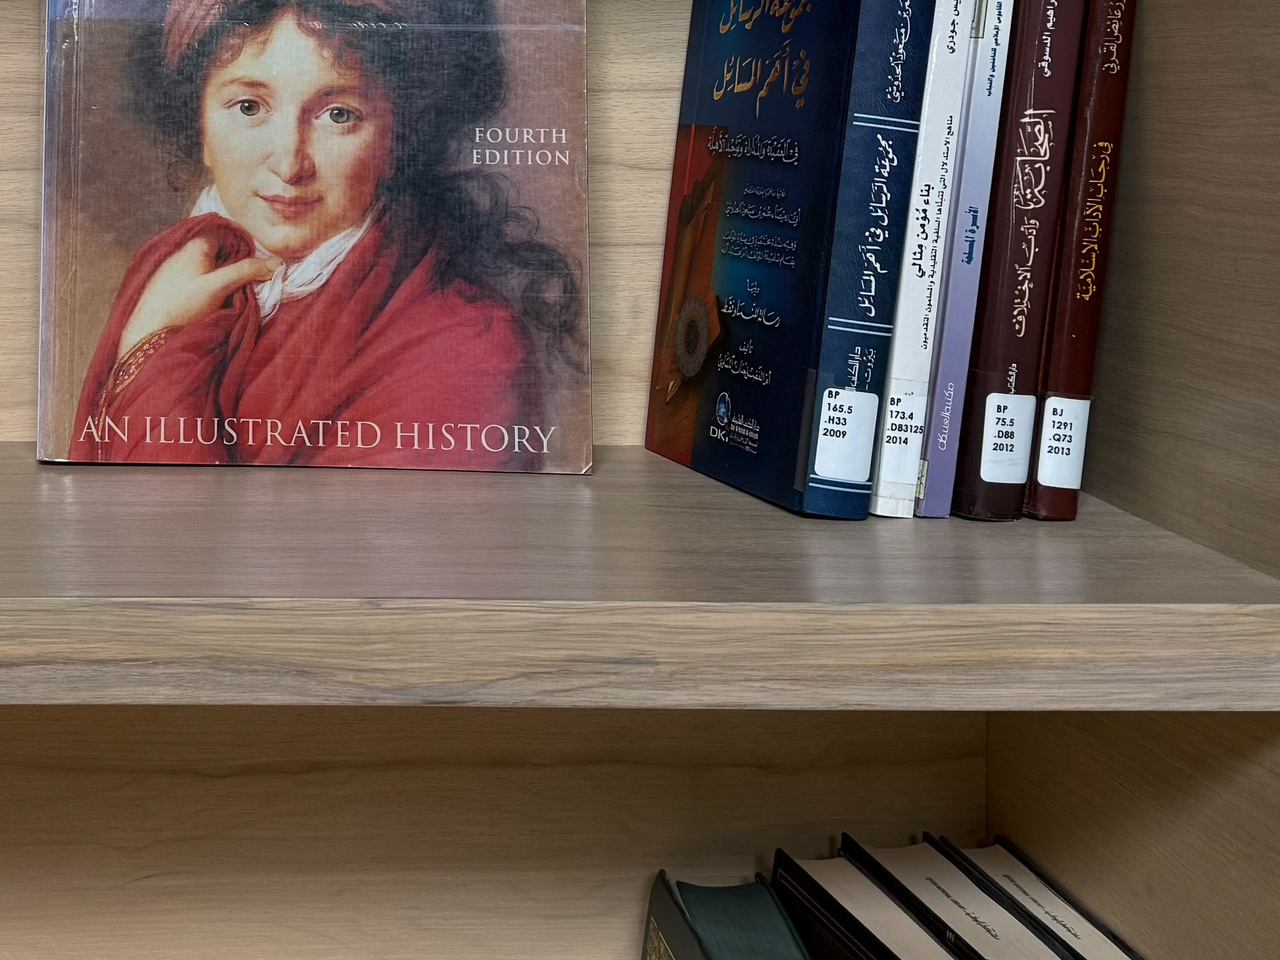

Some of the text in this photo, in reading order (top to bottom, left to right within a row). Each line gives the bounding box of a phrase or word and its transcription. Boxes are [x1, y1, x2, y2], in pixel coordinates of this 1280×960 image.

[945, 18, 959, 54] جودري
[1037, 31, 1056, 77] الدسوقي
[474, 126, 567, 144] FOURTH
[471, 148, 570, 166] EDITION
[917, 183, 934, 205] بناء
[827, 390, 840, 399] BP
[890, 397, 901, 406] BP
[826, 402, 853, 414] 165.5
[996, 404, 1008, 413] BP
[1052, 407, 1064, 417] BJ
[889, 410, 914, 420] 173.4
[824, 416, 847, 426] .H33
[995, 417, 1015, 427] 75.5
[1051, 420, 1073, 431] 1291
[822, 428, 847, 438] 2009
[886, 423, 924, 434] .D83125
[79, 415, 557, 454] AN ILLUSTRATED HISTORY
[994, 430, 1015, 439] .D88
[1049, 433, 1073, 443] .Q73
[885, 435, 908, 445] 2014
[992, 442, 1014, 452] 2012
[1047, 445, 1071, 456] 2013
